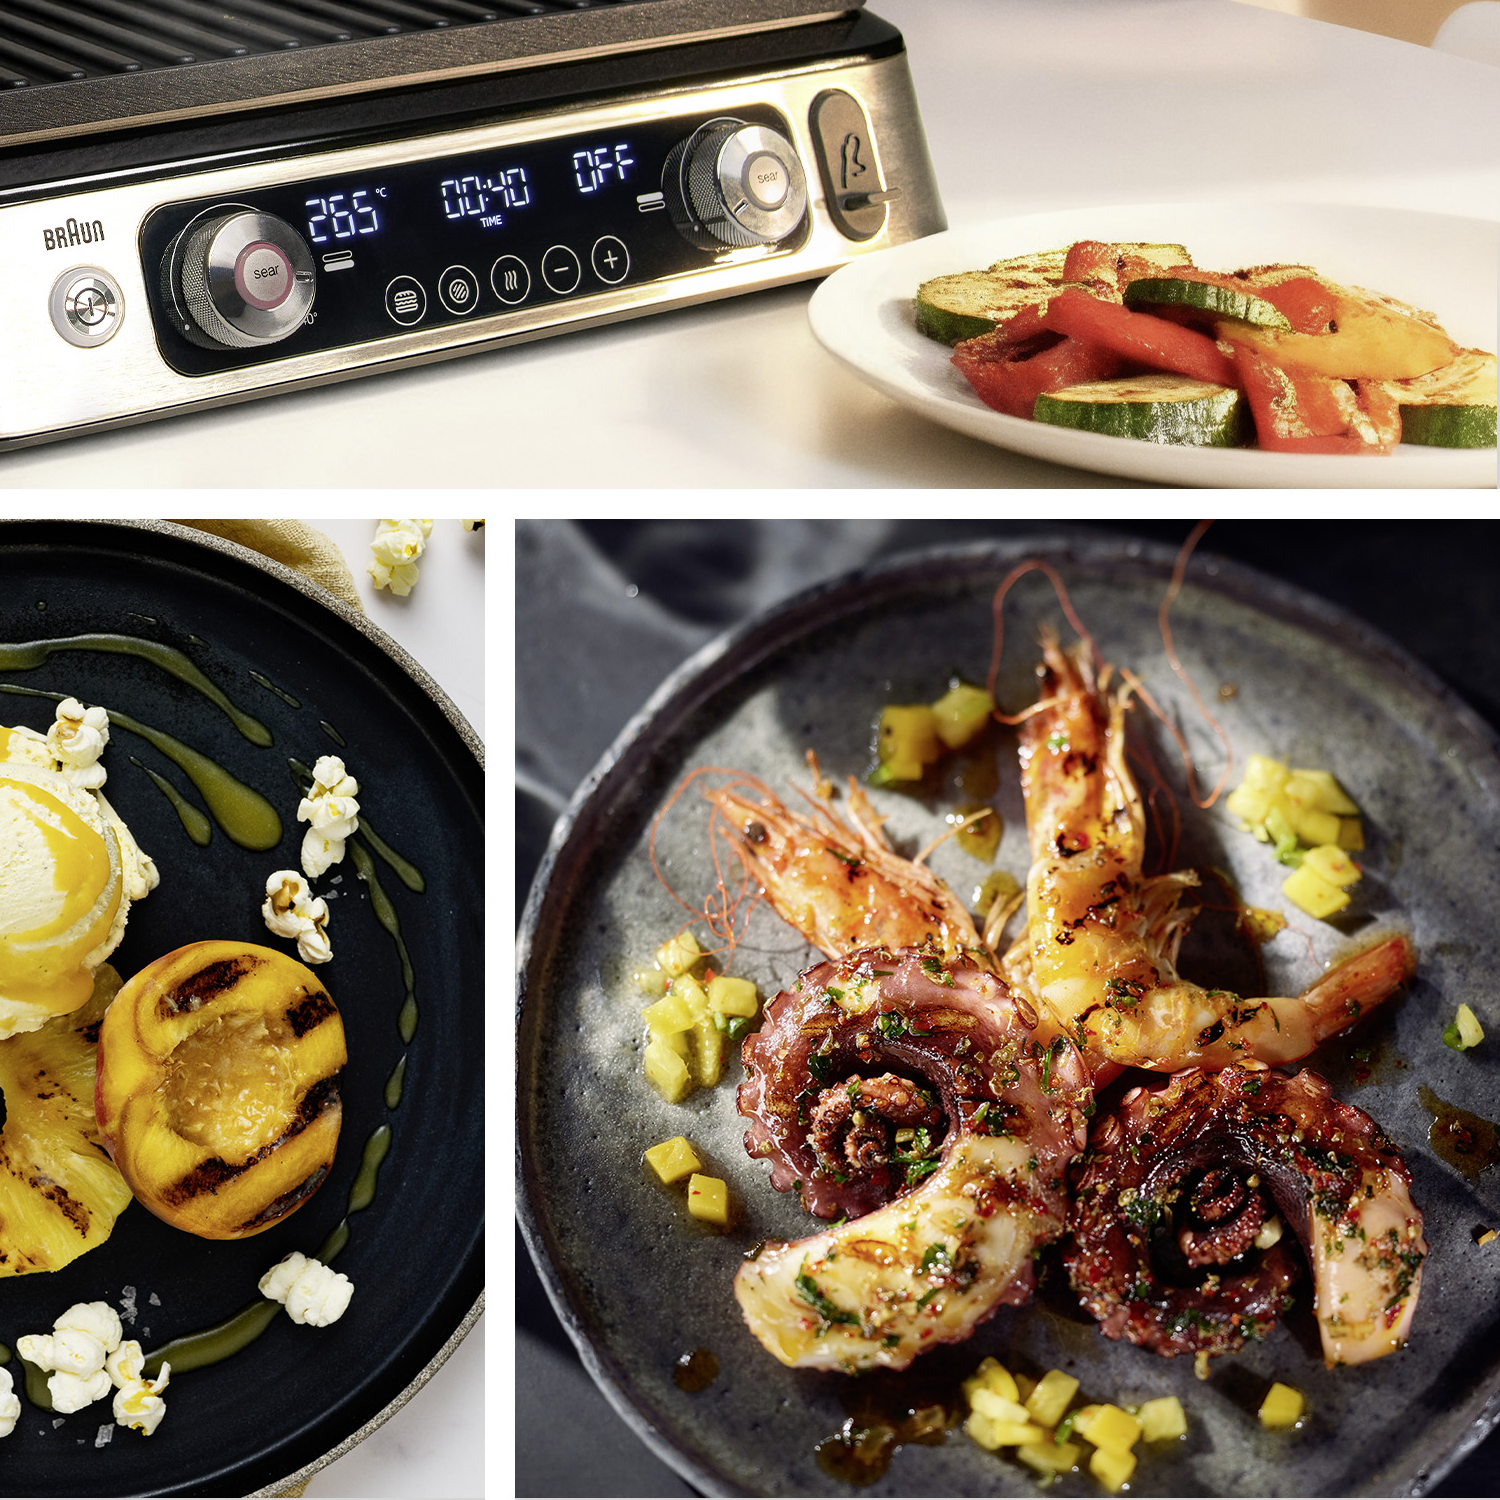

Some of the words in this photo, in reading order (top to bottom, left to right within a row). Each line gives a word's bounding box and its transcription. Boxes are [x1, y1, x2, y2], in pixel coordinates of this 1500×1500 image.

[573, 144, 634, 193] OFF
[758, 170, 779, 183] sear
[440, 167, 531, 219] 00:40
[305, 190, 379, 242] 265
[480, 214, 503, 228] TIME
[43, 217, 105, 251] BRAUN
[253, 264, 279, 280] sear
